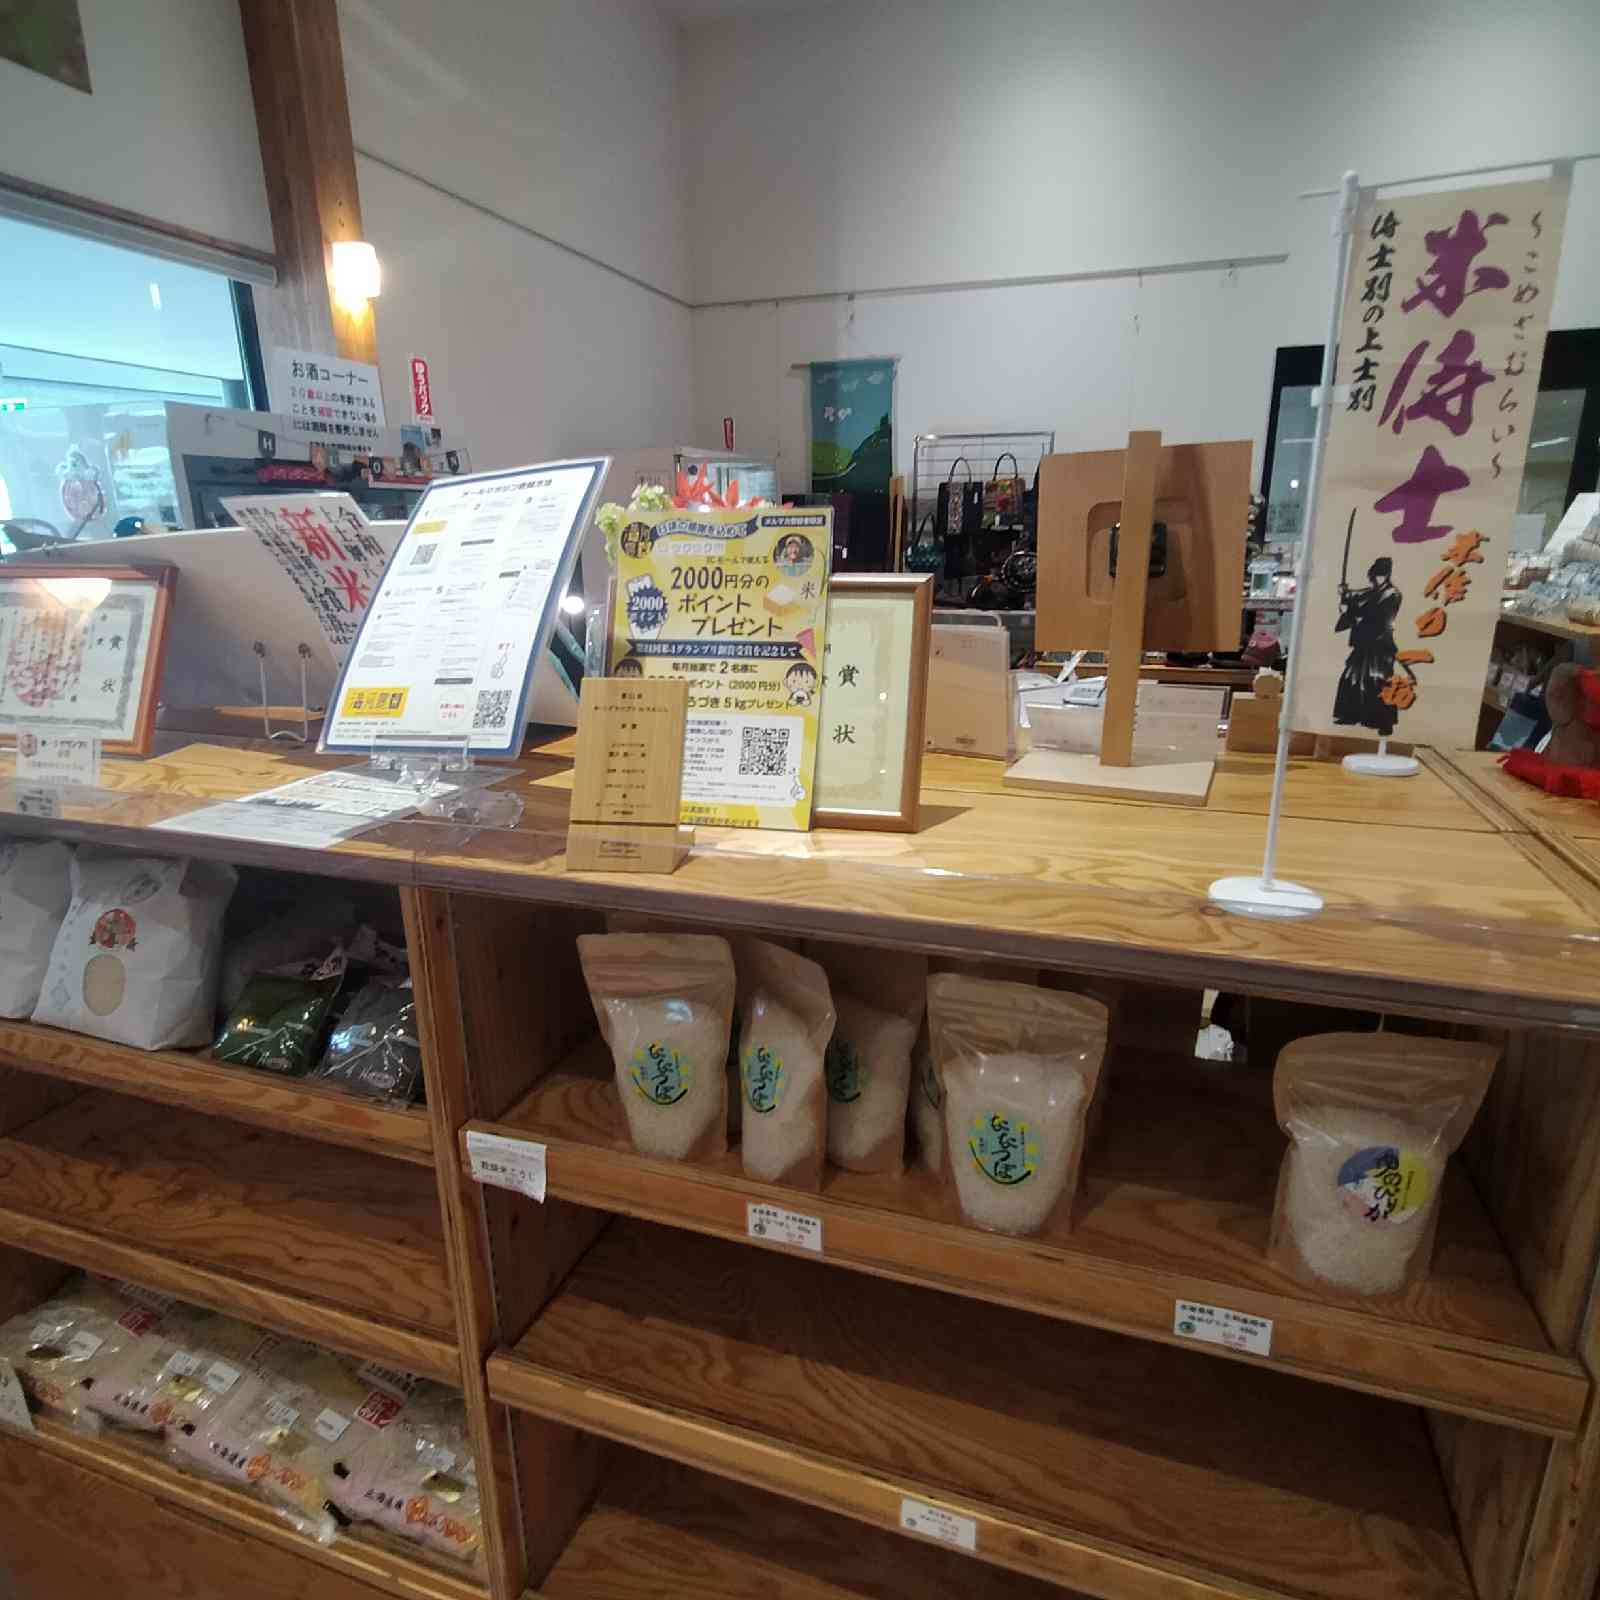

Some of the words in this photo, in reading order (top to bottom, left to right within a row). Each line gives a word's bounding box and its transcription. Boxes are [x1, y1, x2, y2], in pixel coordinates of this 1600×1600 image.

[291, 360, 369, 386] お酒コーナー
[671, 567, 770, 591] 2000円分の
[800, 582, 817, 600] 米
[630, 597, 664, 611] 2000
[678, 593, 752, 614] ポイント
[692, 617, 783, 638] プレゼント
[832, 664, 860, 745] 賞状
